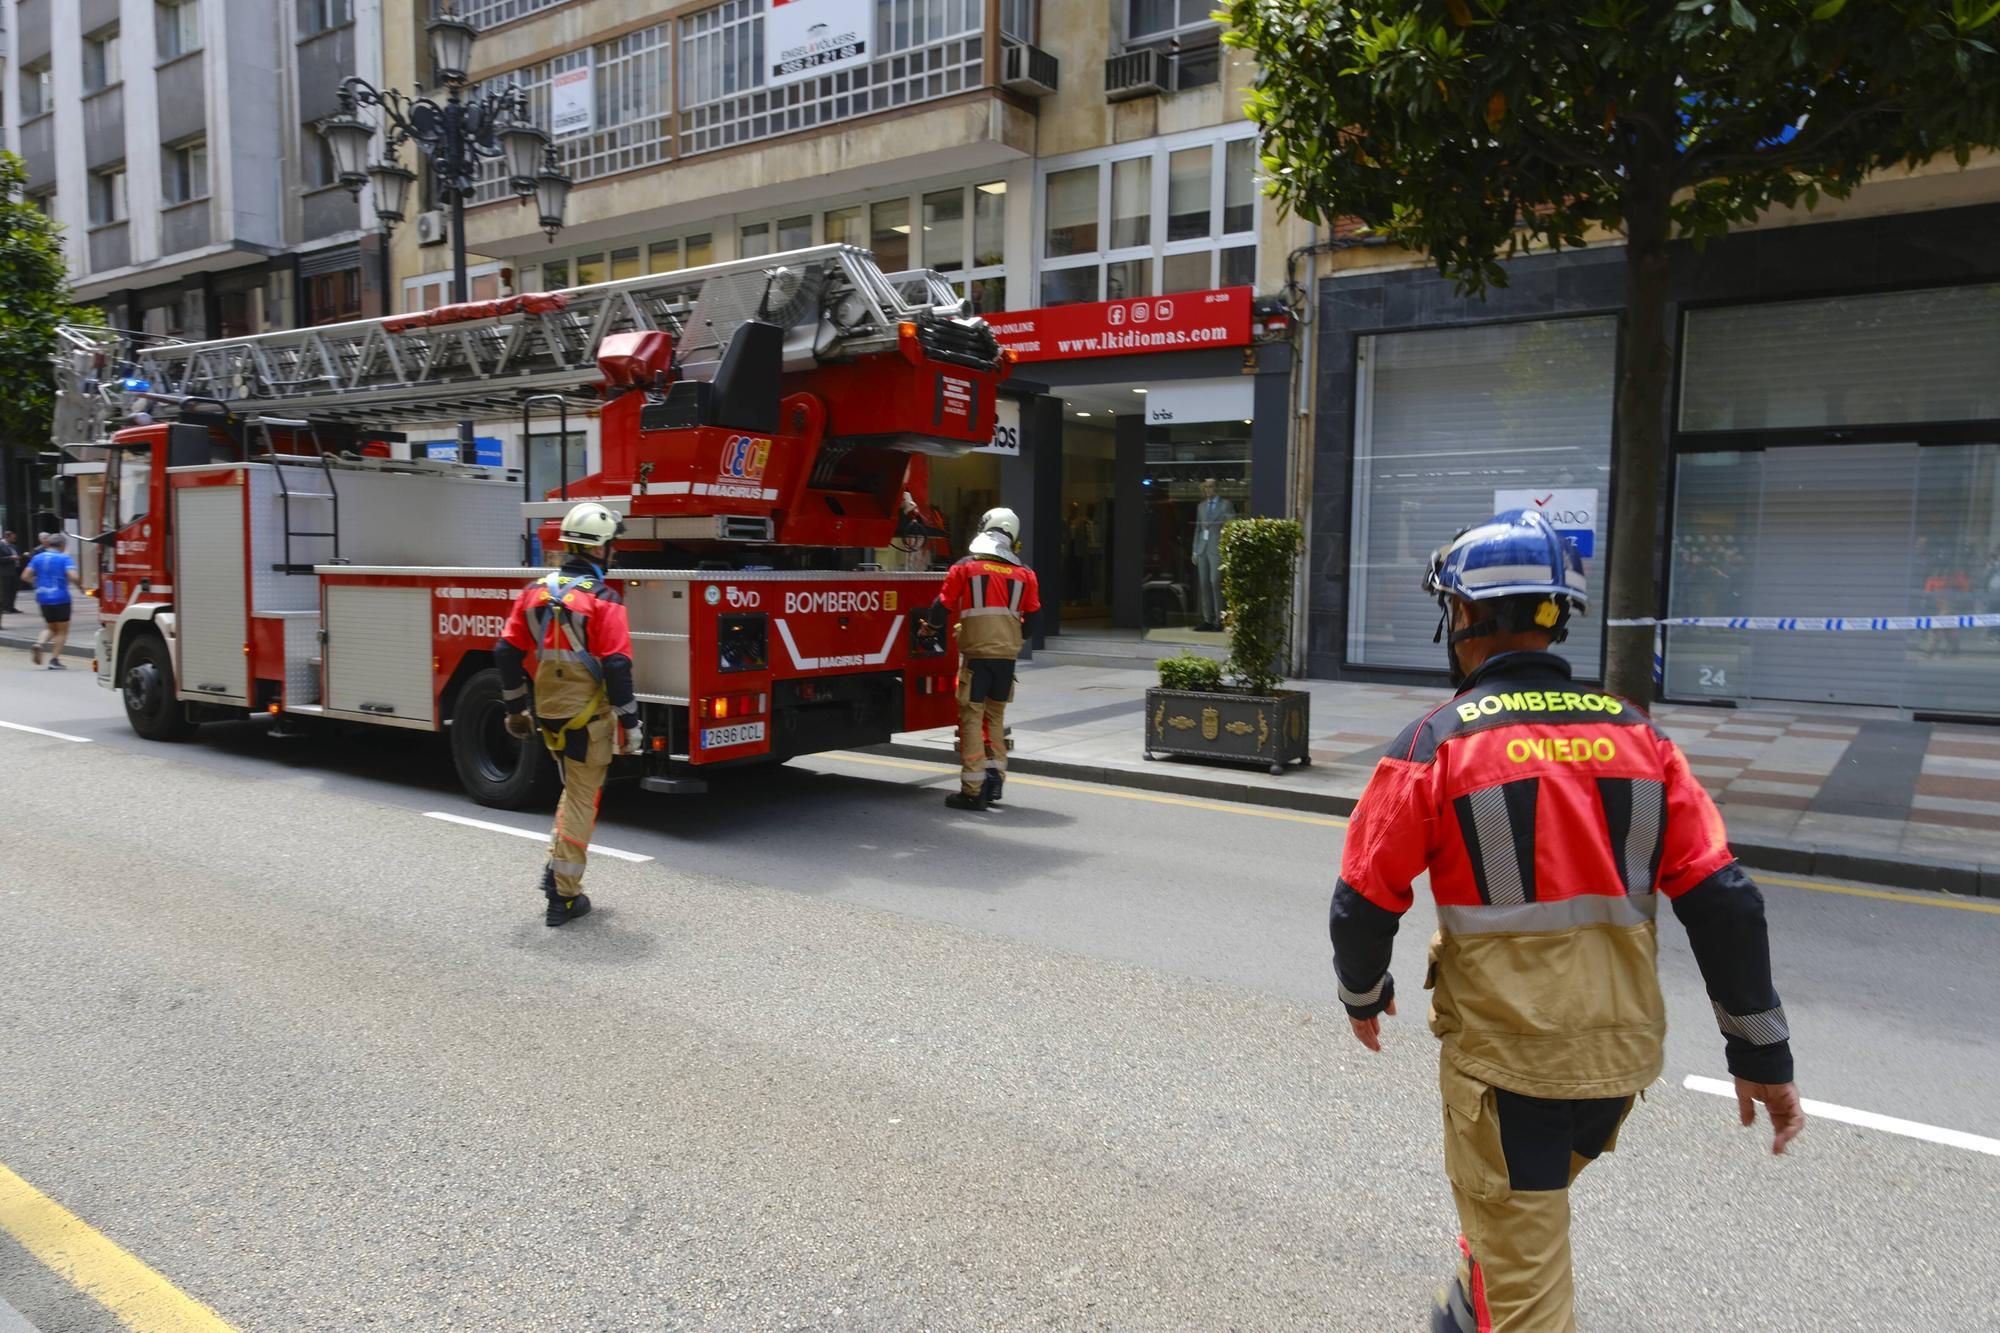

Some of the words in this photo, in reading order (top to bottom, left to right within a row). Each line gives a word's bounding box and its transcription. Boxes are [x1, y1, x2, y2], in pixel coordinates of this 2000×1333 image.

[1057, 325, 1227, 352] www.lkidiomas.com
[708, 484, 762, 499] MAGIRUS
[466, 588, 508, 599] MAGIRUS
[785, 591, 880, 613] BOMBEROS
[438, 613, 506, 638] BOMBER
[819, 654, 864, 669] MAGIRUS
[1699, 668, 1726, 687] 24
[1456, 692, 1623, 722] BOMBEROS
[708, 728, 737, 746] 2696
[740, 725, 761, 741] CCL
[1506, 737, 1616, 763] OVIEDO
